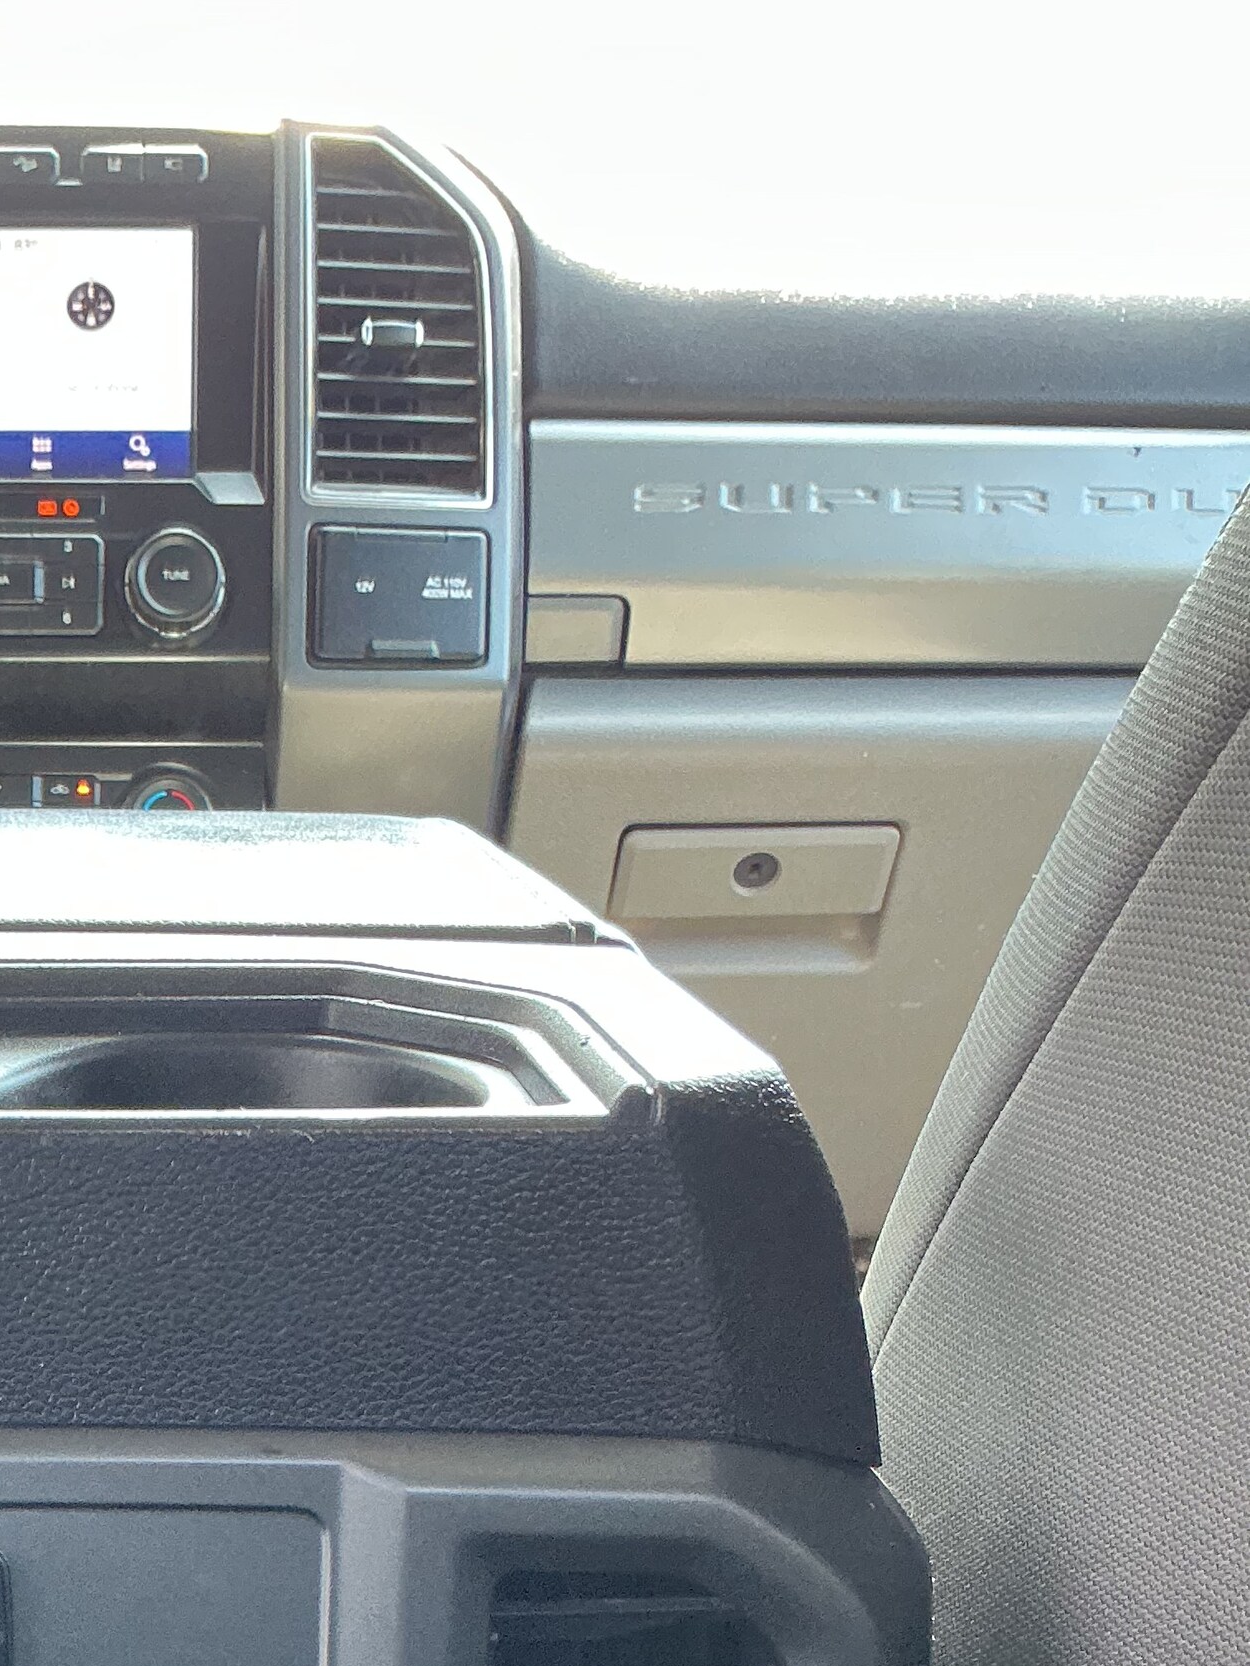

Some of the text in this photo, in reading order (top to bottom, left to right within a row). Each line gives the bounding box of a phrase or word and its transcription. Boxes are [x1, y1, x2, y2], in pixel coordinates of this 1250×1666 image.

[634, 481, 1049, 515] SUPER
[64, 540, 73, 553] 3
[162, 569, 190, 581] TUNE
[426, 576, 442, 588] AC
[450, 587, 473, 600] MAX
[62, 610, 71, 625] 6
